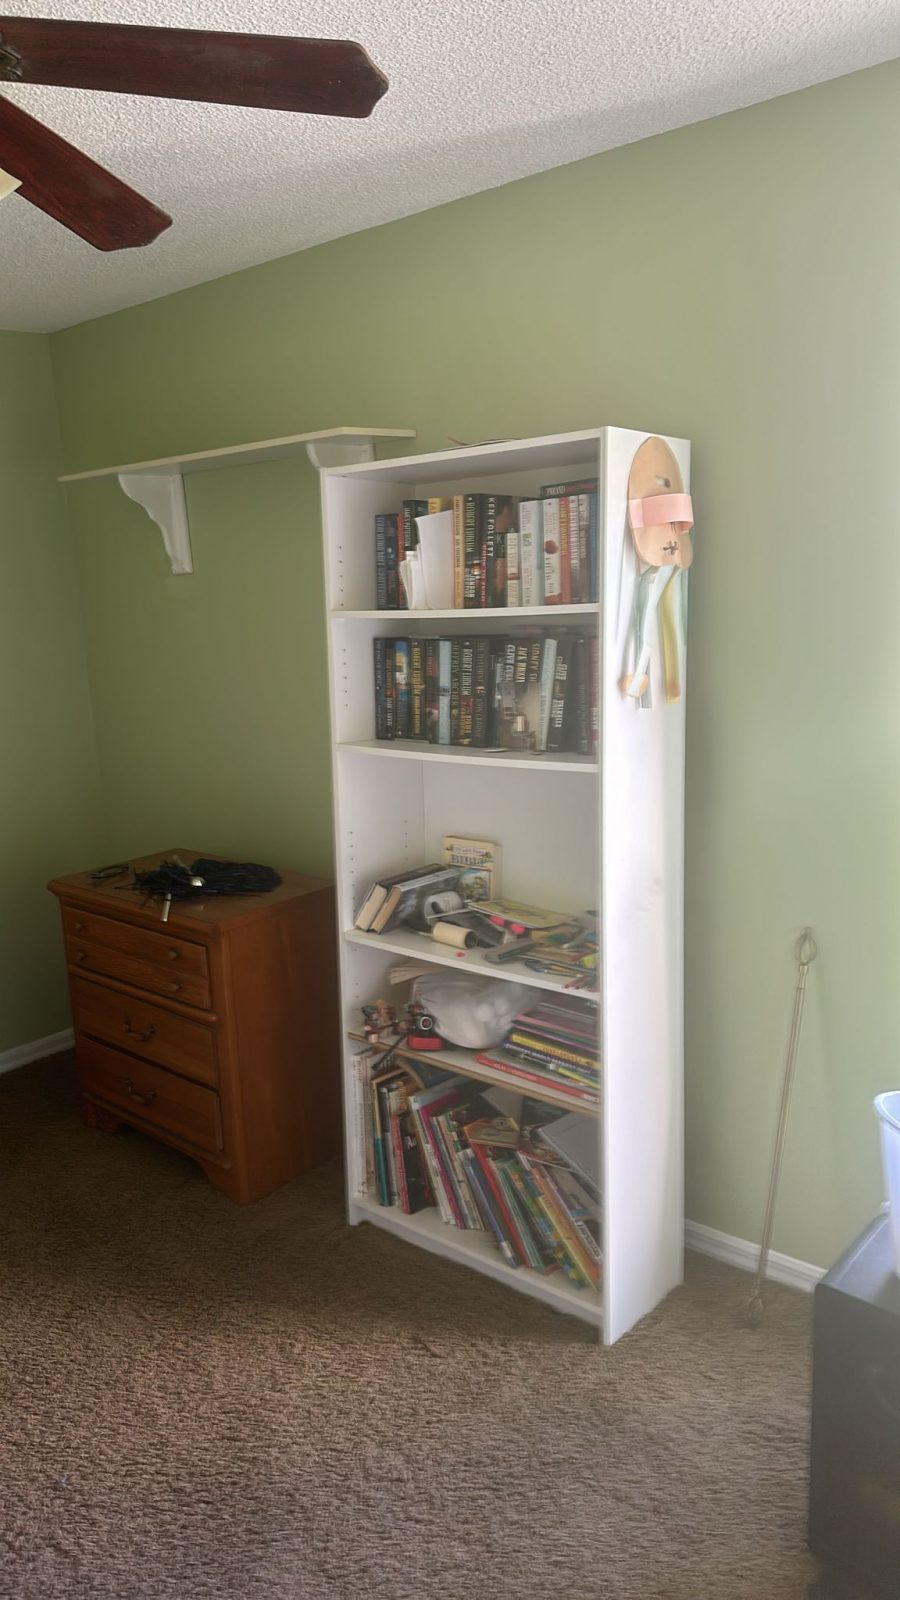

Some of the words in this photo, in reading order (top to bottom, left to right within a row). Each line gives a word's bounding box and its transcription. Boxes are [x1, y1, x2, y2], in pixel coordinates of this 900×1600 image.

[466, 501, 476, 526] ROBERT
[487, 497, 495, 515] KEN
[466, 527, 476, 553] LUDLUM
[486, 518, 494, 557] FOLLETT
[451, 644, 459, 674] JEFFREY
[461, 648, 473, 671] ROBERT
[507, 644, 516, 664] CLIVE
[529, 643, 540, 670] SIDNEY
[451, 677, 459, 706] ARCHER
[461, 672, 473, 696] LUDLUM
